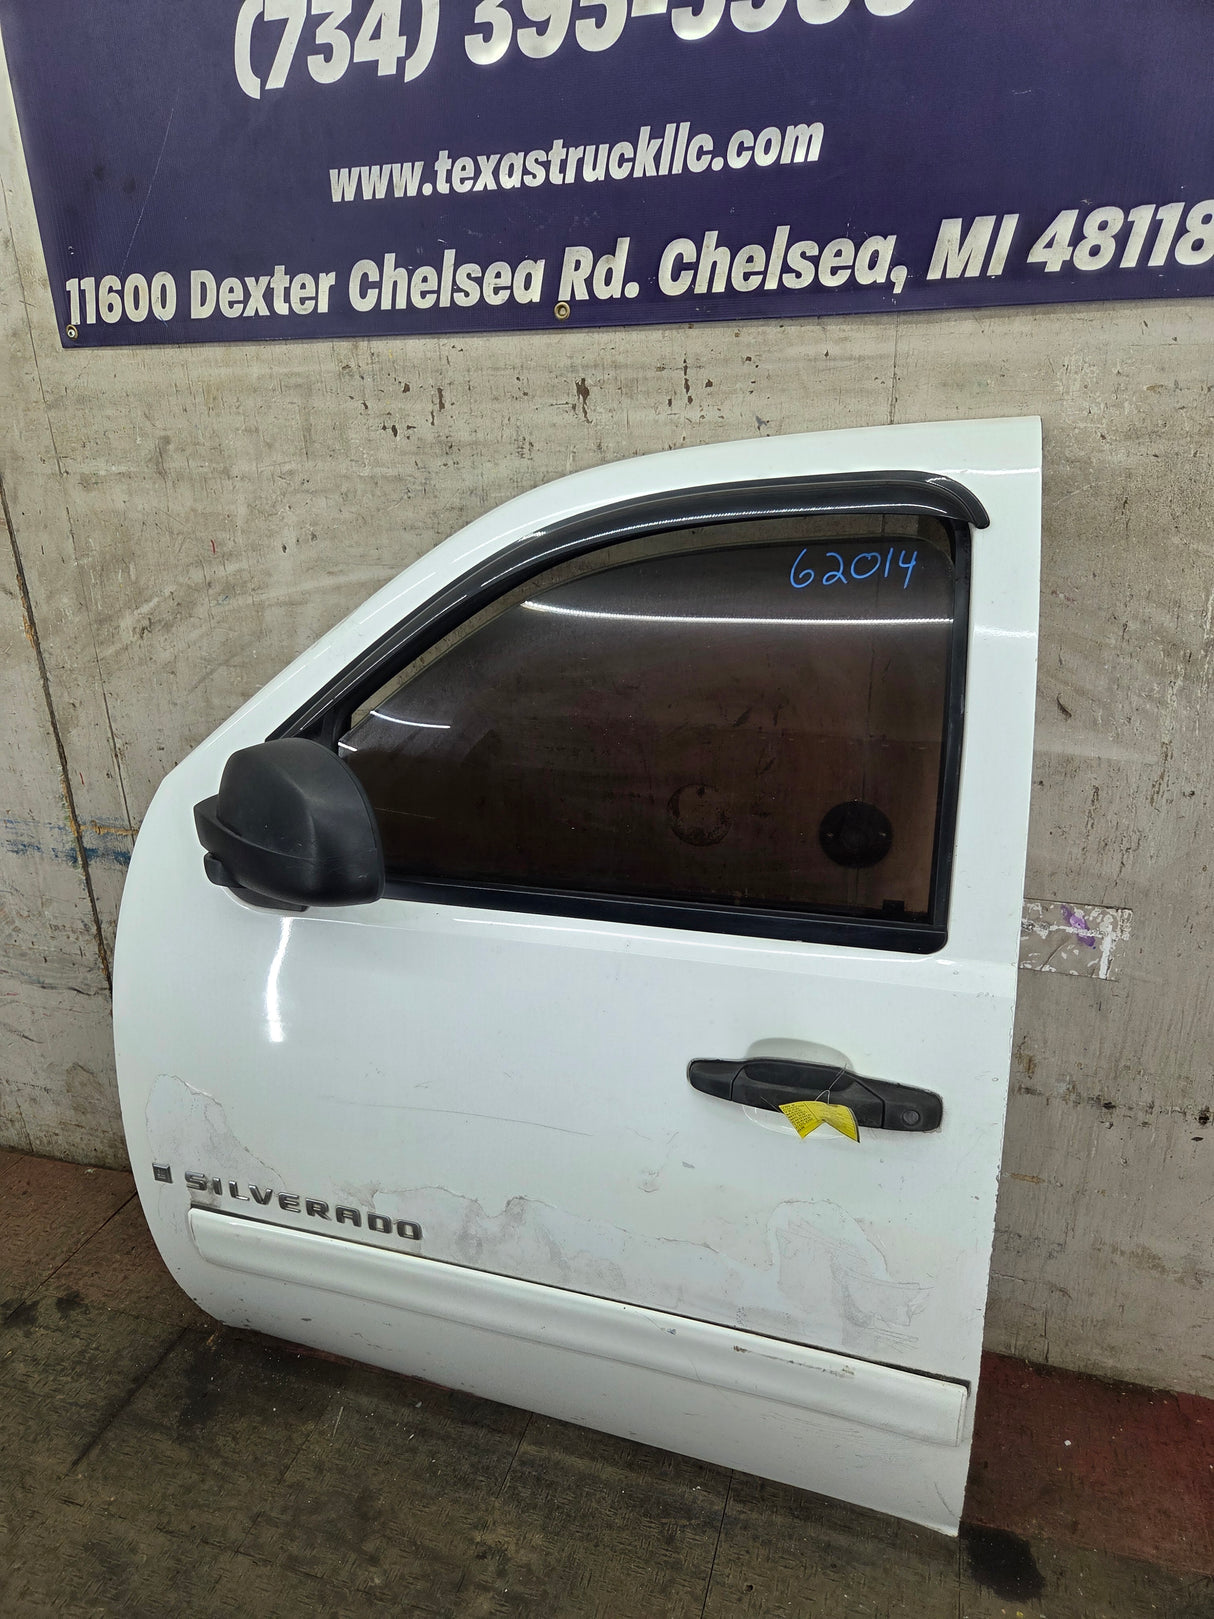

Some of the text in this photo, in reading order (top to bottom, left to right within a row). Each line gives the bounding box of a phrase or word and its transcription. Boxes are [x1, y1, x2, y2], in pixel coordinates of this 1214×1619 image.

[234, 0, 440, 100] (734)
[329, 121, 825, 203] www.texastruckllc.com
[66, 199, 1214, 326] 11600 Dexter Chelsea Rd. Chelsea, MI 48118
[789, 547, 918, 589] 62014
[184, 1170, 423, 1241] SILVERADO
